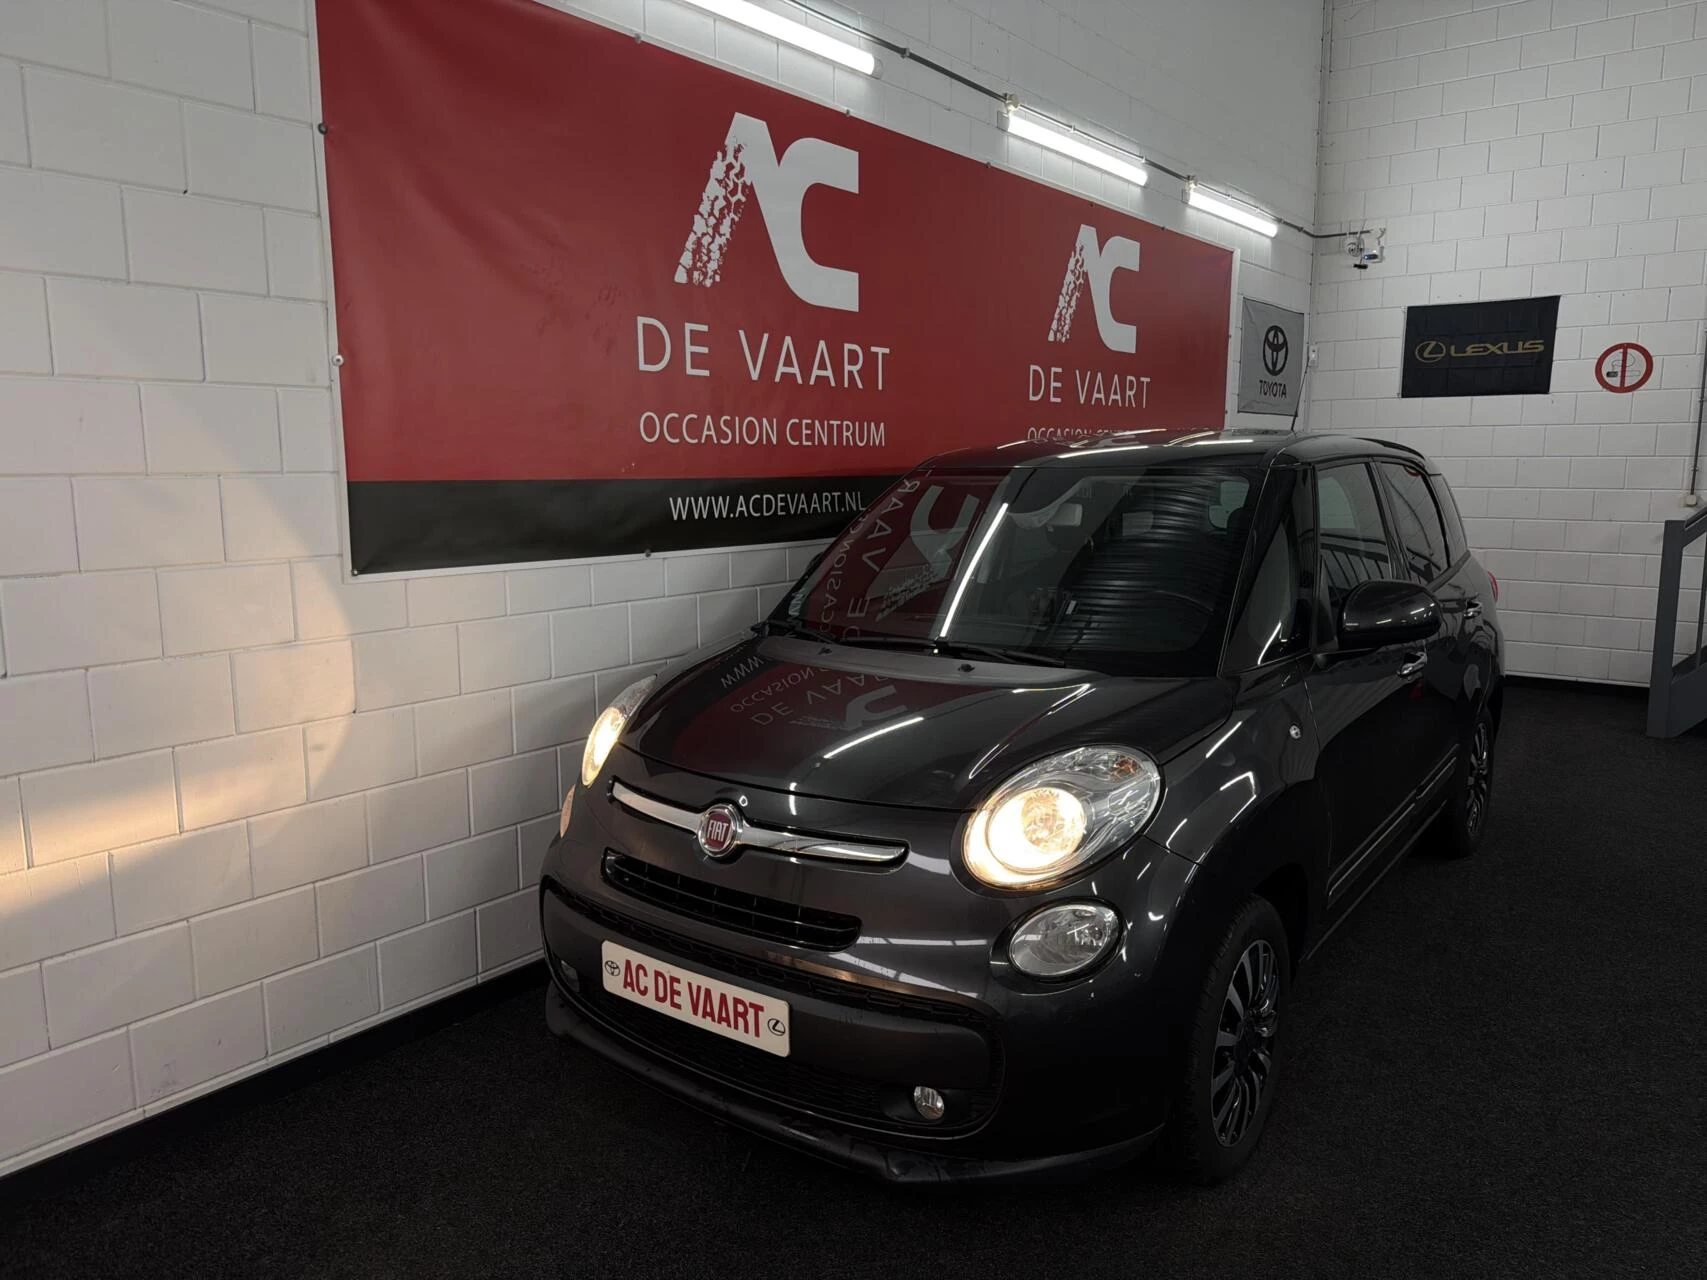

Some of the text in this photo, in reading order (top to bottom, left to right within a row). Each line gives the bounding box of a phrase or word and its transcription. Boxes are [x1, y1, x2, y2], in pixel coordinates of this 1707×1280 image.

[674, 112, 860, 312] AC
[1048, 224, 1141, 354] AC
[636, 315, 890, 391] DE VAART
[1450, 338, 1545, 357] LEXUS
[1028, 364, 1151, 409] DE VAART
[1258, 378, 1288, 399] TOYOTA
[639, 410, 886, 448] OCCASION CENTRUM
[668, 490, 867, 521] WWW.ACDEVAART.NL
[706, 819, 729, 842] FIAT
[622, 958, 765, 1040] AC DE VAART
